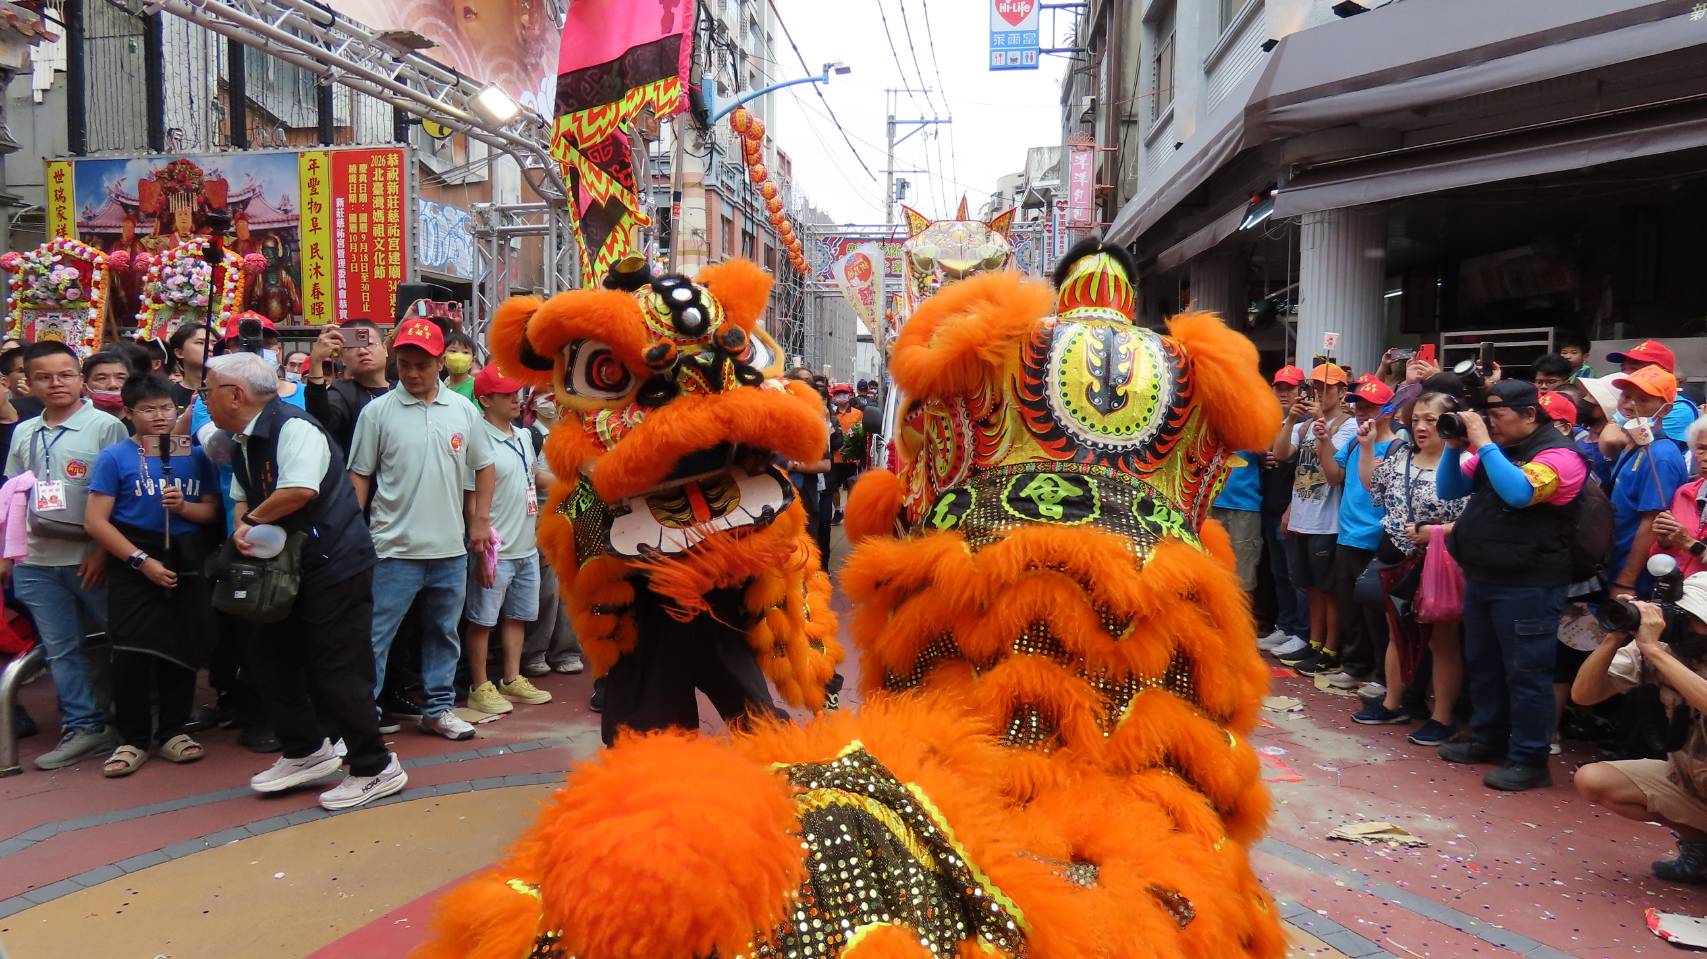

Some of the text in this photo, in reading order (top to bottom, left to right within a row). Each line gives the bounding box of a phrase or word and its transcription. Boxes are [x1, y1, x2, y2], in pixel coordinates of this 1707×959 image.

[999, 2, 1031, 17] Hi-Life
[993, 32, 1036, 46] 萊爾富
[361, 777, 381, 793] HOKA
